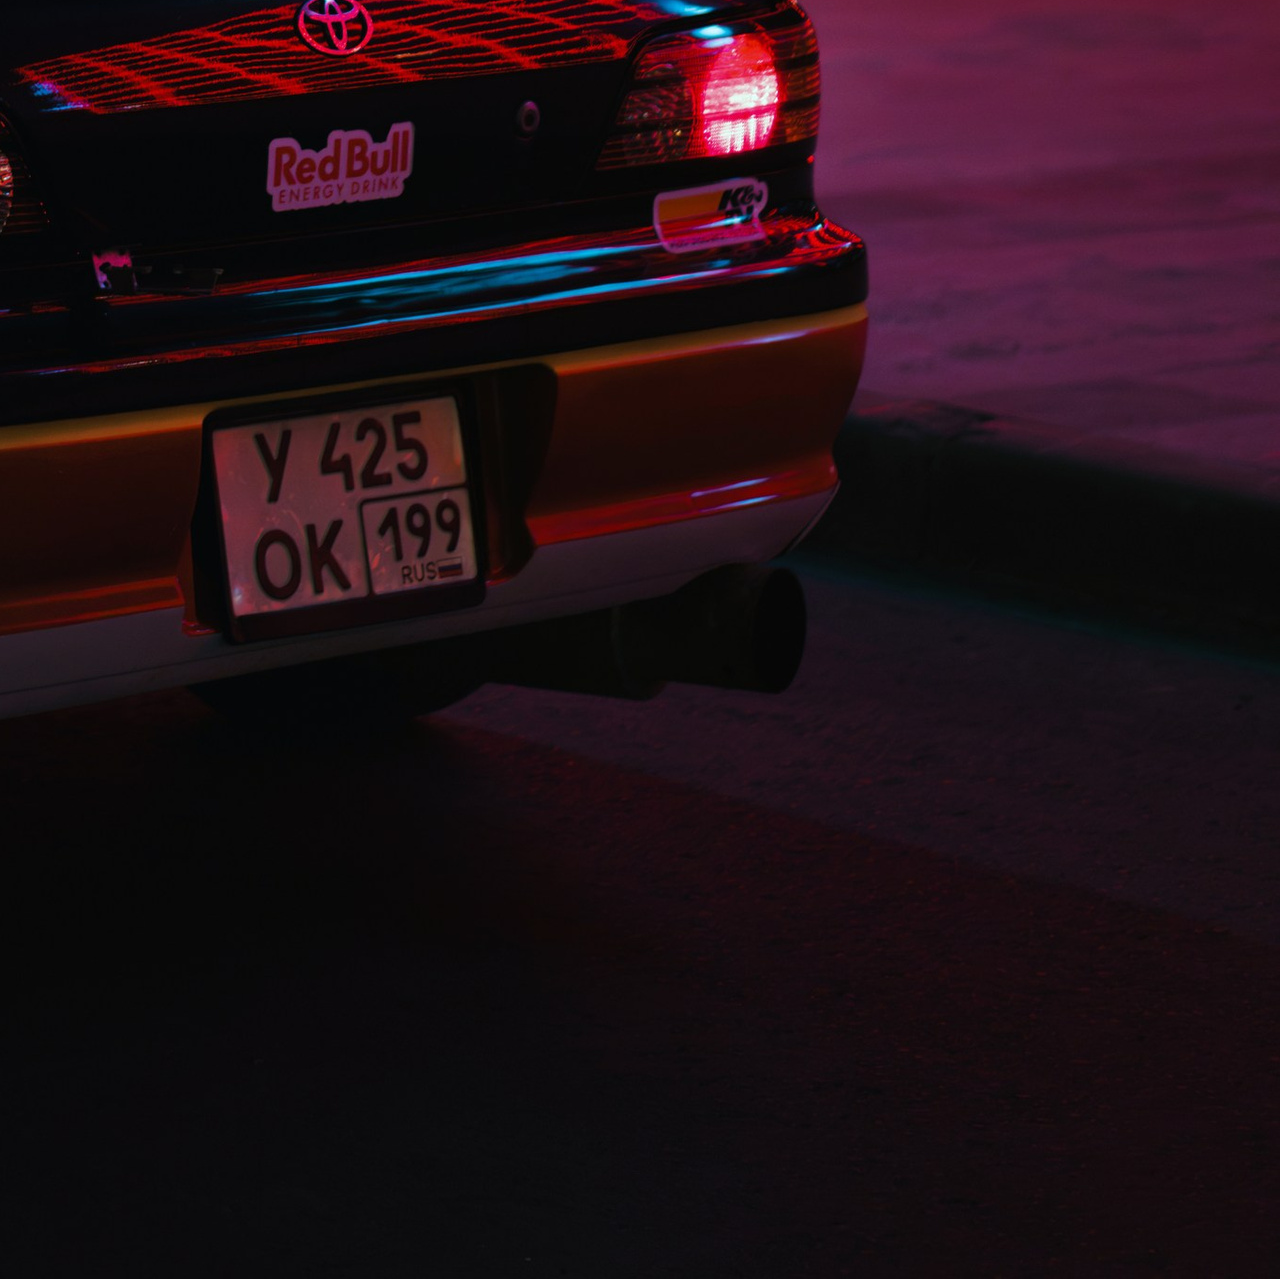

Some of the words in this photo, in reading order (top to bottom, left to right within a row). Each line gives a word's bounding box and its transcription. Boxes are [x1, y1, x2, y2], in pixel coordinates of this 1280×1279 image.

[273, 138, 342, 187] Red
[346, 130, 409, 178] Bull
[278, 183, 344, 204] ENERGY
[350, 176, 399, 196] DRINK
[321, 411, 428, 491] 425
[378, 498, 460, 562] 199
[402, 561, 437, 584] RUS
